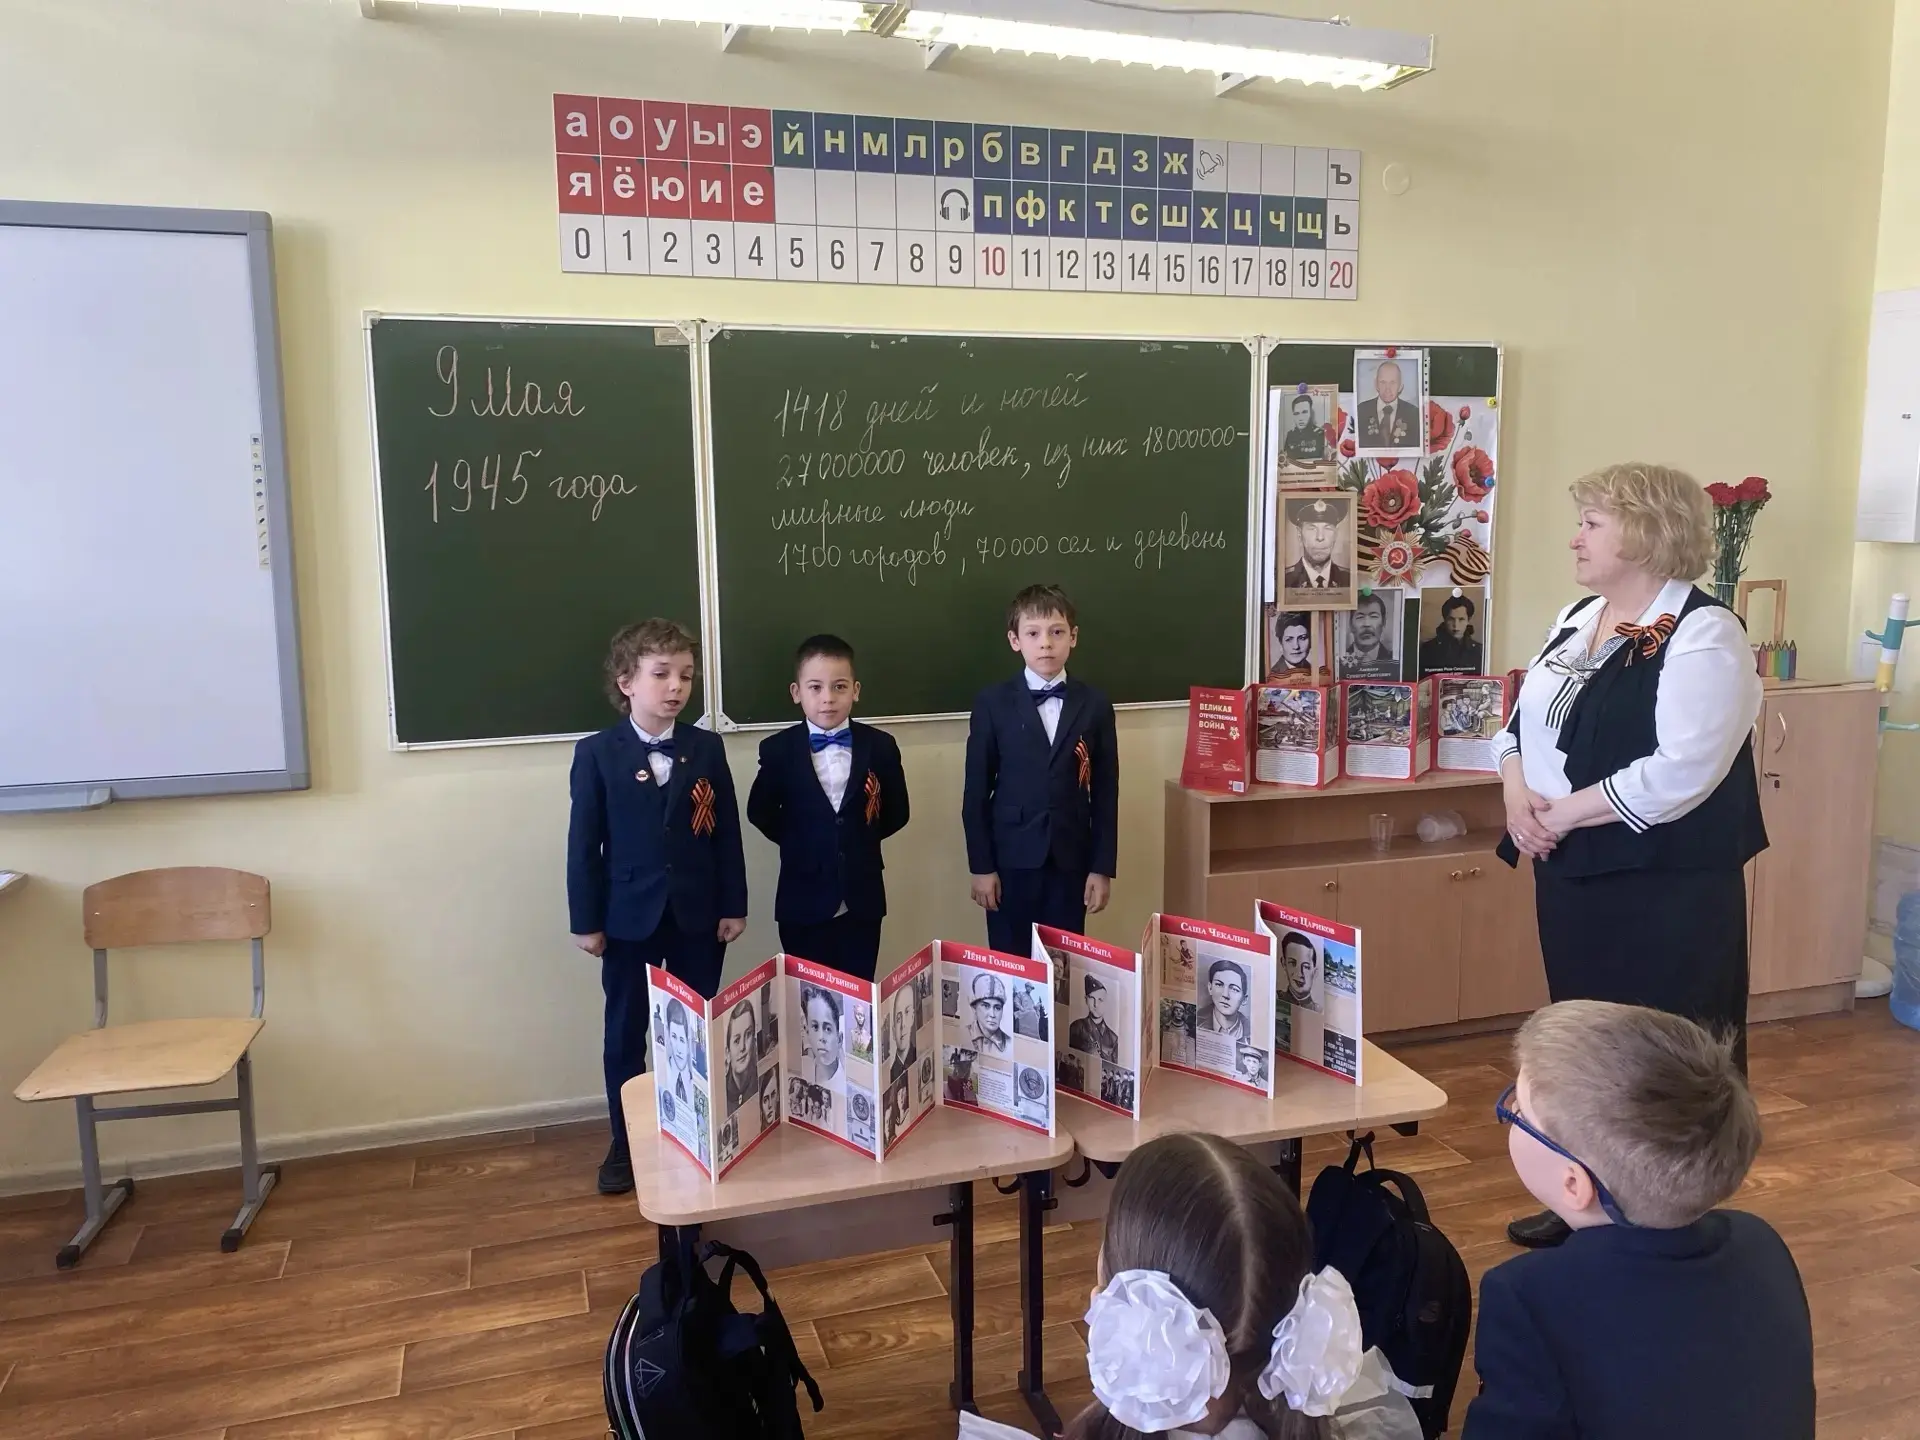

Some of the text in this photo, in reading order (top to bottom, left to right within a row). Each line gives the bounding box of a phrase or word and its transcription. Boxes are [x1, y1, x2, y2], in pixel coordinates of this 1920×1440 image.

[566, 112, 1351, 185] а о у ы э й н м л р б в г д з ж ъ
[569, 167, 1350, 239] я ё ю и е п ф к т с ш х ц ч щ ь
[575, 228, 1352, 288] 0 1 2 3 4 5 6 7 8 9 10 11 12 13 14 15 16 17 18 19 20
[428, 345, 458, 416] 9
[774, 372, 1088, 454] 1418 дней и ночей
[424, 449, 637, 523] 1945 года
[923, 426, 1030, 480] человек,
[1044, 442, 1071, 489] из
[1082, 435, 1128, 457] них
[771, 499, 975, 551] мирные люди
[778, 543, 841, 575] 1700
[977, 535, 1049, 563] 70000
[1058, 536, 1096, 554] сел
[1107, 535, 1122, 550] и
[1134, 511, 1226, 569] деревень
[1199, 713, 1237, 721] ОТЕЧЕСТВЕННАЯ
[1199, 721, 1225, 730] ВОЙНА
[1200, 703, 1232, 712] ВЕЛИКАЯ
